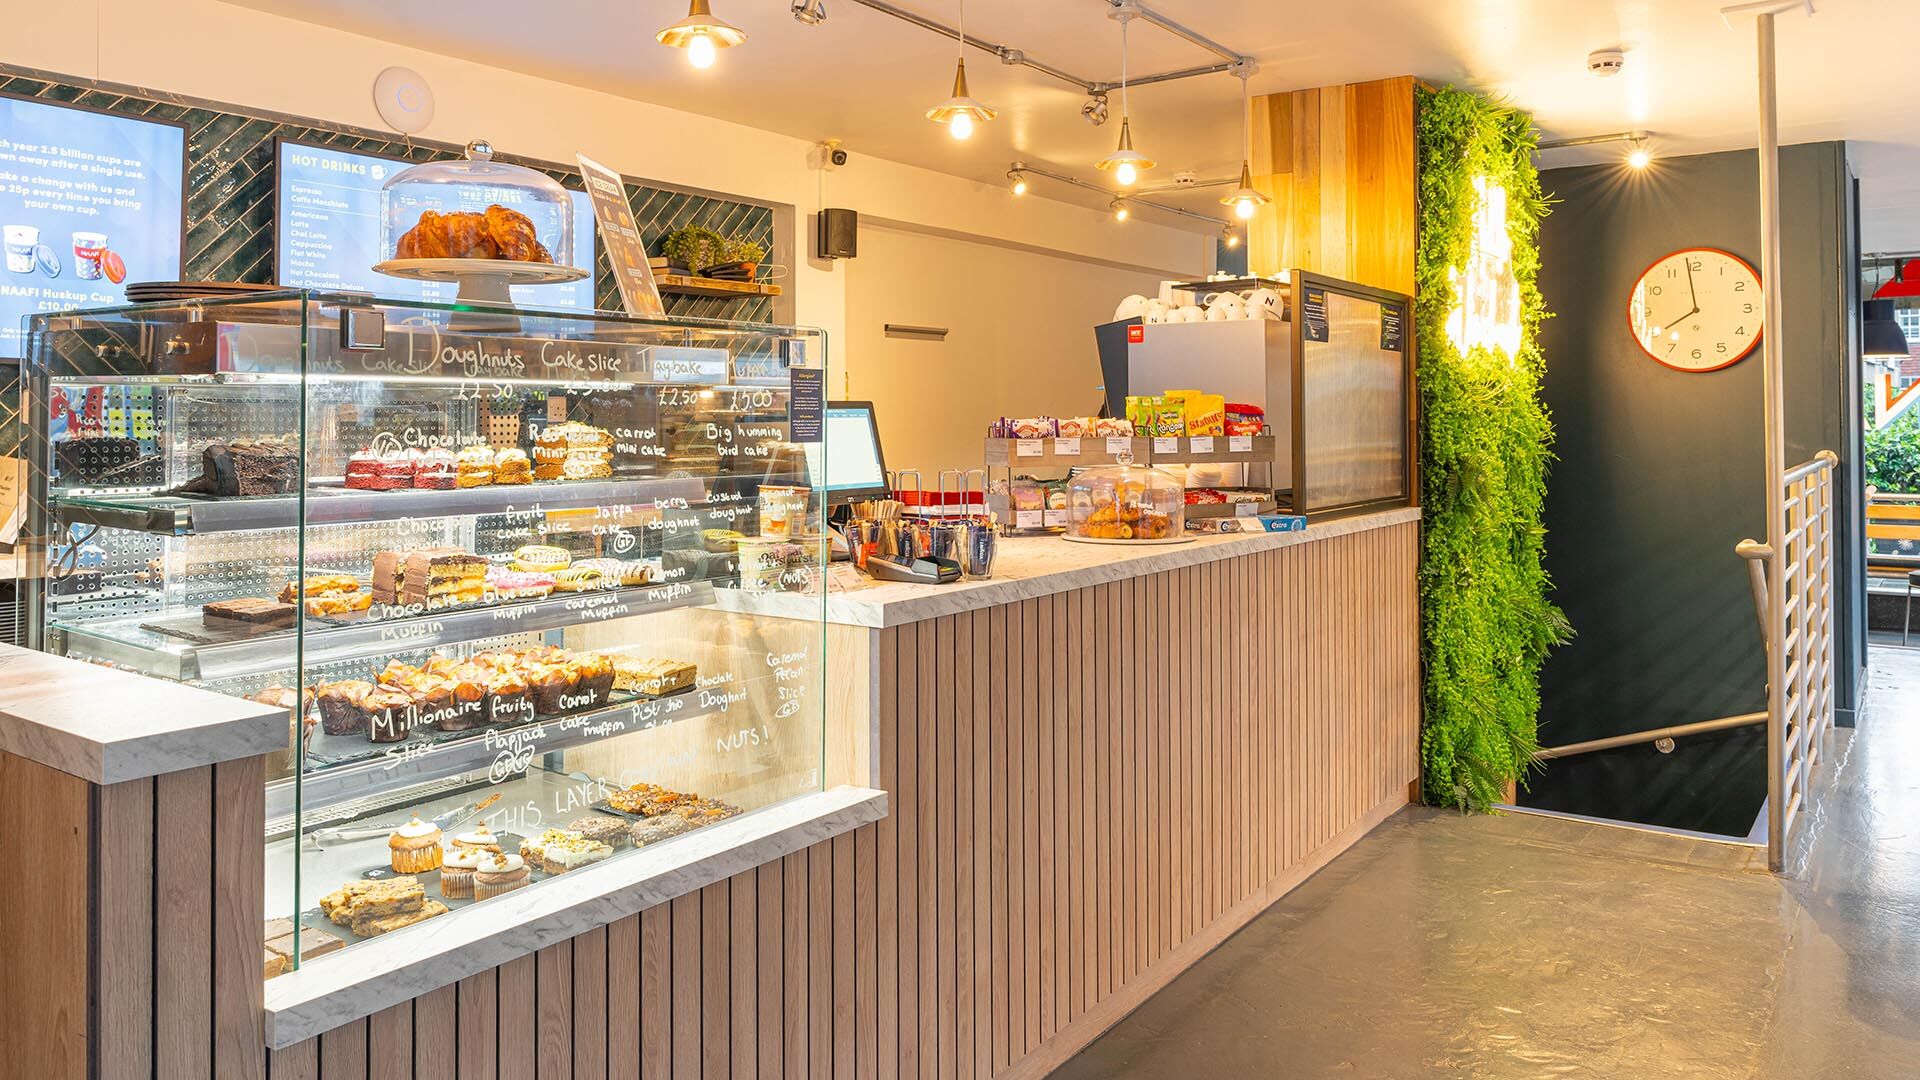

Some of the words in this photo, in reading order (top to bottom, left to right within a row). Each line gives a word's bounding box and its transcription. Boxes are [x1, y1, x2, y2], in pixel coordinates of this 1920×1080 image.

[12, 143, 38, 152] year
[41, 145, 58, 155] 2.5
[60, 148, 94, 161] billion
[96, 155, 121, 165] cups
[19, 156, 49, 167] away
[51, 160, 79, 169] after
[91, 166, 122, 177] single
[125, 171, 146, 179] use.
[292, 154, 318, 167] HOT
[322, 158, 366, 175] DRINKS
[31, 176, 72, 189] change
[75, 181, 97, 191] with
[115, 188, 135, 196] and
[291, 185, 322, 195] Espresso
[8, 185, 30, 196] 25p
[32, 189, 63, 200] every
[66, 192, 90, 201] time
[92, 196, 111, 205] you
[114, 198, 141, 210] bring
[24, 200, 49, 208] your
[52, 203, 74, 211] own
[77, 206, 99, 216] cup.
[291, 209, 329, 221] Americano
[291, 219, 309, 228] Latte
[291, 239, 333, 251] Cappuccino
[291, 249, 304, 257] Flat
[306, 251, 326, 260] White
[290, 259, 315, 267] Mocha
[304, 270, 340, 280] Chocolate
[290, 279, 303, 287] Hot
[304, 280, 340, 290] Chocolate
[1649, 286, 1662, 296] 10
[1735, 281, 1745, 292] 2
[1, 286, 38, 297] NAAFI
[43, 288, 87, 301] Huskup
[91, 292, 114, 304] Cup
[1743, 303, 1753, 314] 3
[1735, 326, 1745, 336] 4
[400, 317, 525, 377] Doughnuts
[1668, 343, 1677, 353] 7
[1716, 343, 1727, 353] 5
[541, 341, 585, 371] Cake
[588, 351, 622, 372] Slice
[1691, 349, 1702, 360] 6
[659, 385, 699, 406] £2.50
[729, 388, 773, 412] £5.00
[615, 427, 657, 440] carrot
[706, 424, 732, 440] Big
[737, 424, 783, 441] humming
[616, 443, 637, 455] mini
[641, 445, 667, 457] cake
[717, 444, 739, 457] bird
[744, 446, 769, 457] cake
[655, 498, 688, 510] berry
[506, 503, 545, 524] fruit
[594, 504, 633, 520] Jaffa
[592, 524, 623, 537] cake
[648, 516, 700, 534] doughnut
[1271, 520, 1287, 529] extra
[497, 529, 532, 540] cake
[648, 582, 692, 603] Muffin
[491, 695, 535, 722] fruity
[371, 700, 482, 741] Millionaire
[484, 799, 543, 836] THIS
[555, 778, 613, 814] LAYER
